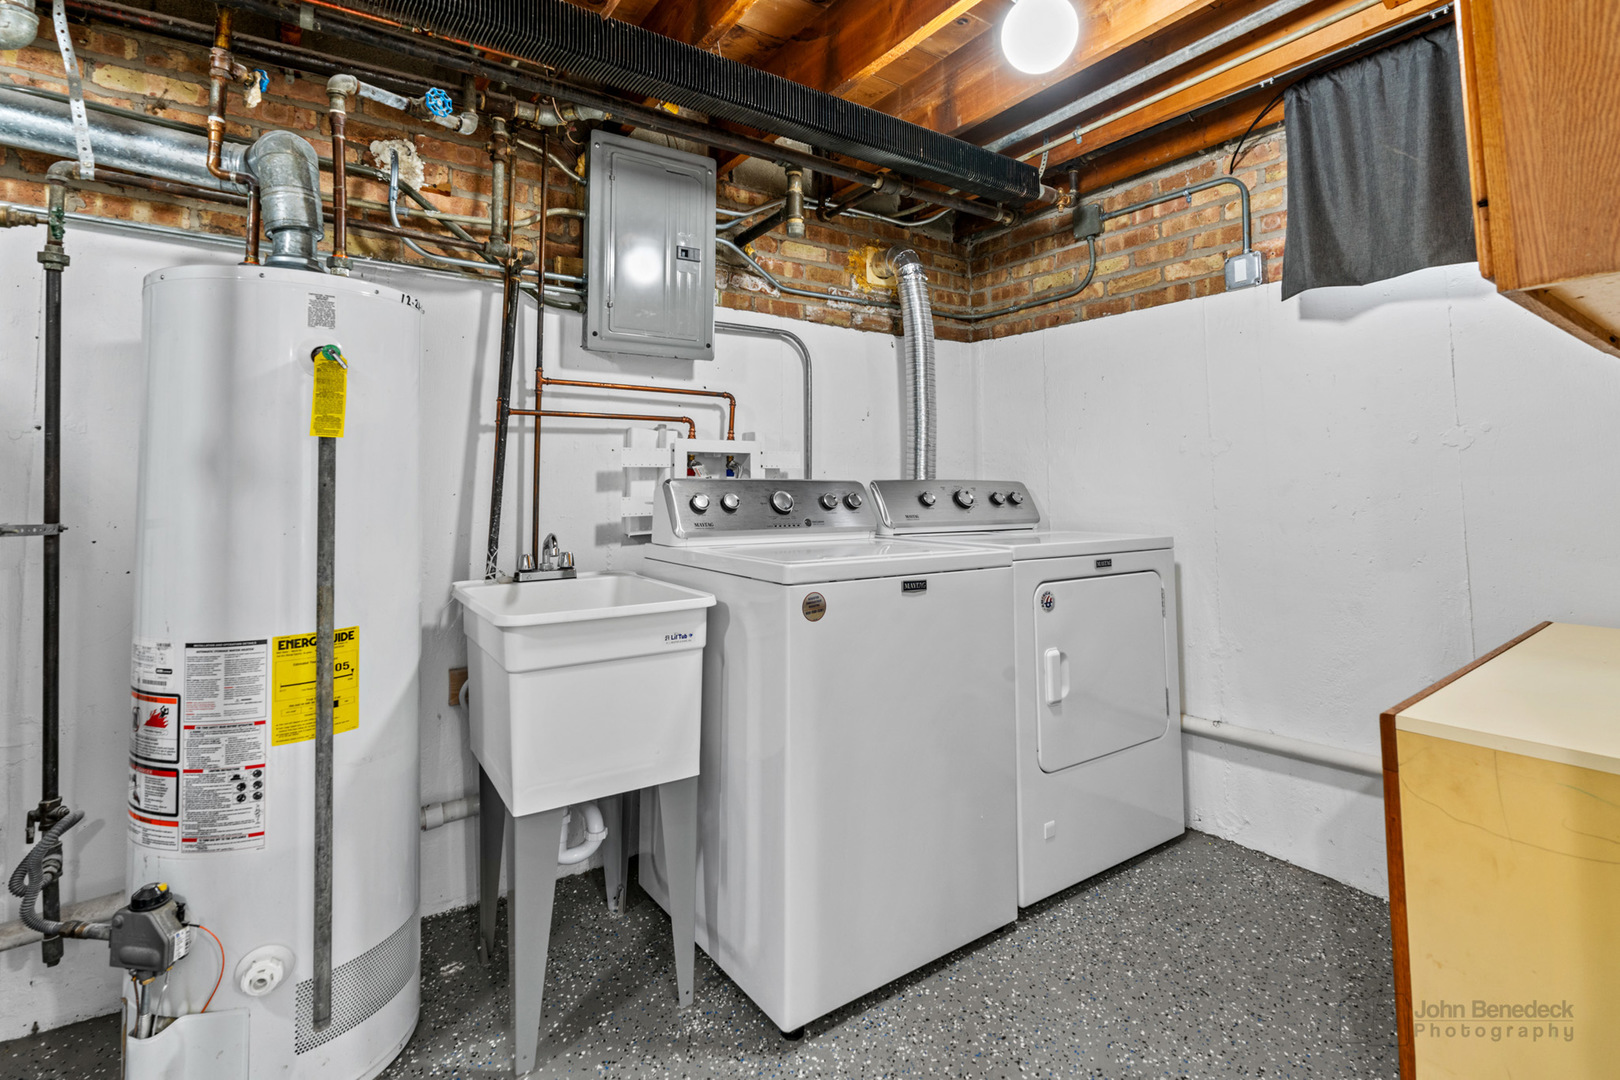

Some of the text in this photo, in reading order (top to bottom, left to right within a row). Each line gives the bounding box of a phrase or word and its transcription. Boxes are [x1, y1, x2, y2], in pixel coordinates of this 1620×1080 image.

[904, 582, 927, 590] MAYTAG
[278, 630, 355, 650] ENERGUIDE
[335, 661, 350, 672] 05
